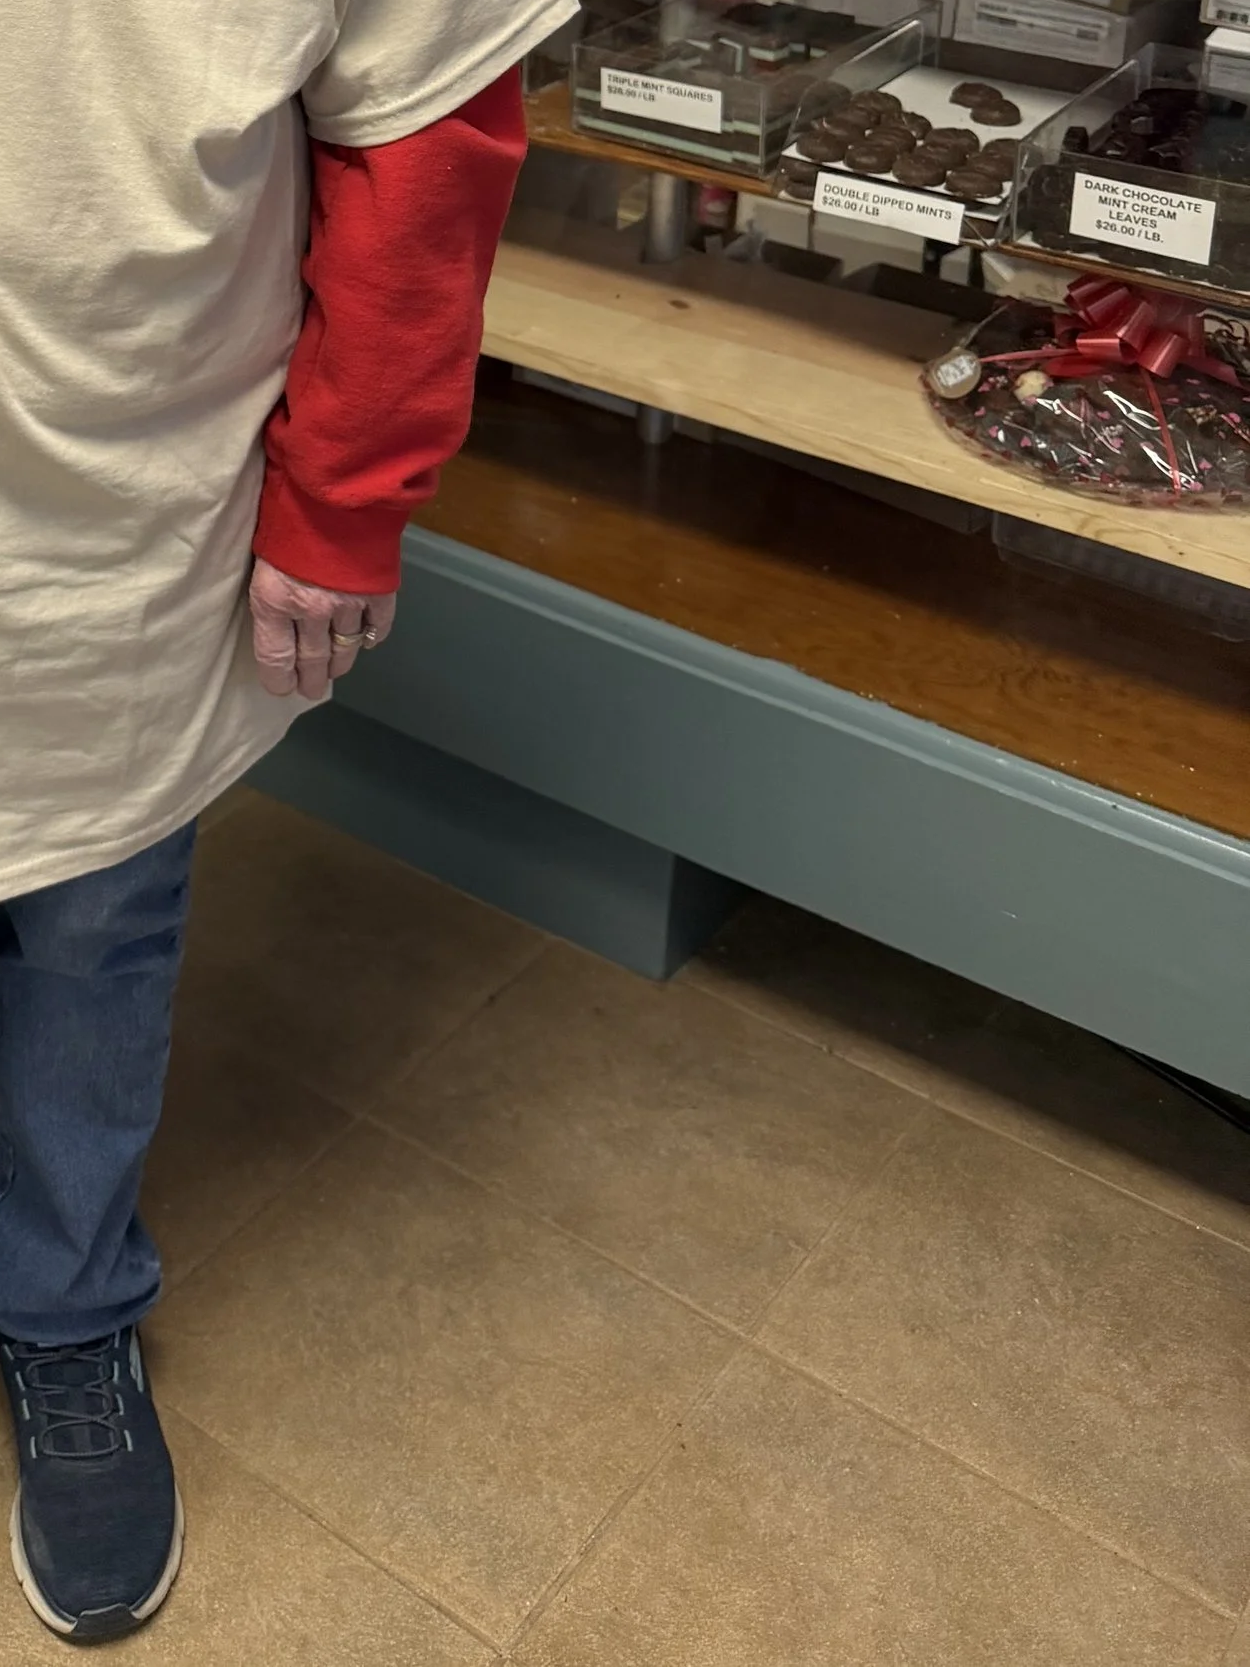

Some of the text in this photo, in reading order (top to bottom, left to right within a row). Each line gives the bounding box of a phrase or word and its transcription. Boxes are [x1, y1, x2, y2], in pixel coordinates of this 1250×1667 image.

[824, 183, 952, 220] DOUBLE DIPPED MINTS
[1084, 179, 1202, 214] DARK CHOCOLATE
[1098, 195, 1177, 220] MINT CREAM
[1095, 219, 1135, 236] $26.00
[1109, 210, 1157, 229] LEAVES
